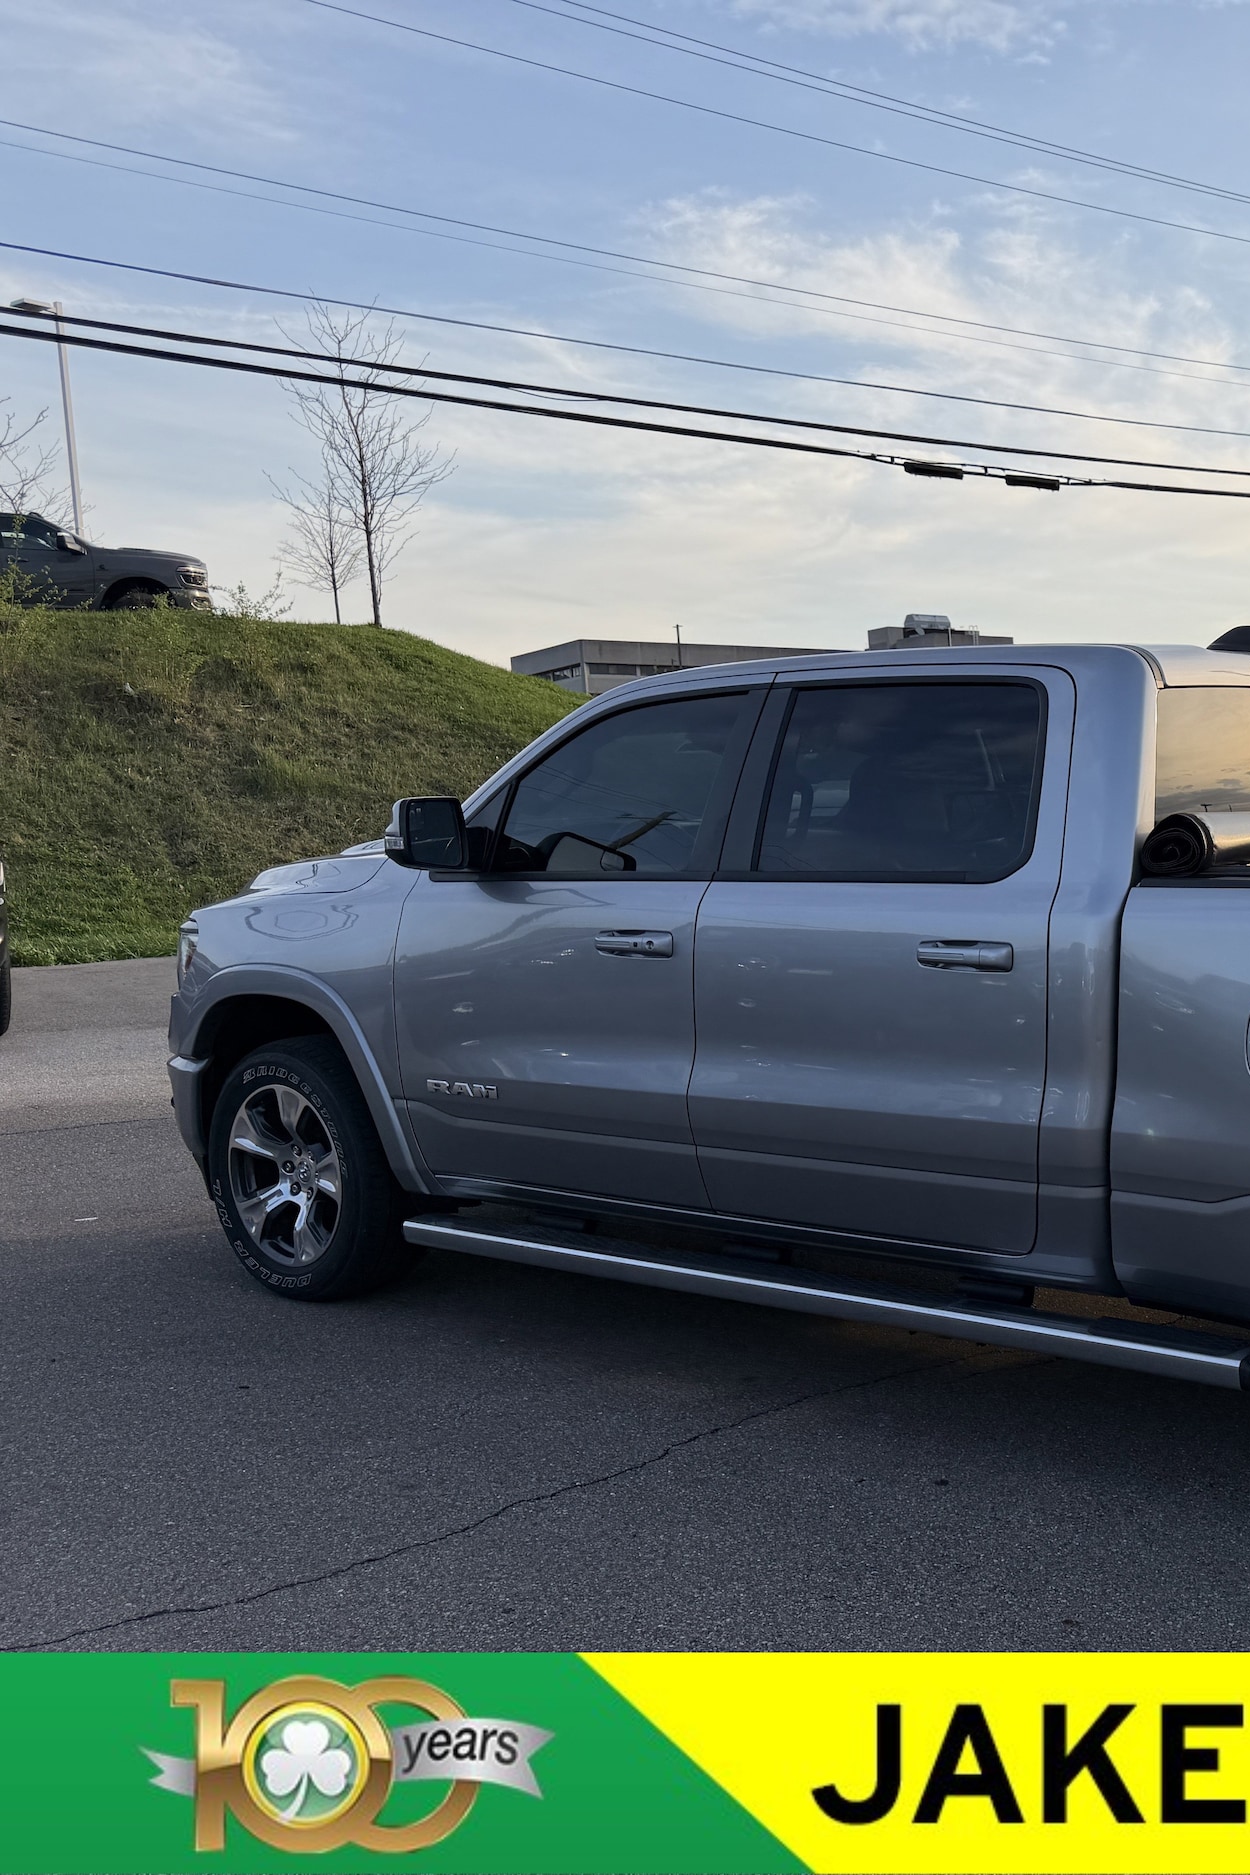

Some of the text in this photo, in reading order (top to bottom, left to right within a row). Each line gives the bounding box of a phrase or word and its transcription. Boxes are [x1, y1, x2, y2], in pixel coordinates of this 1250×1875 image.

[426, 1078, 499, 1100] RAM
[242, 1065, 348, 1179] BRIDGESTONE
[234, 1240, 312, 1288] DUELER
